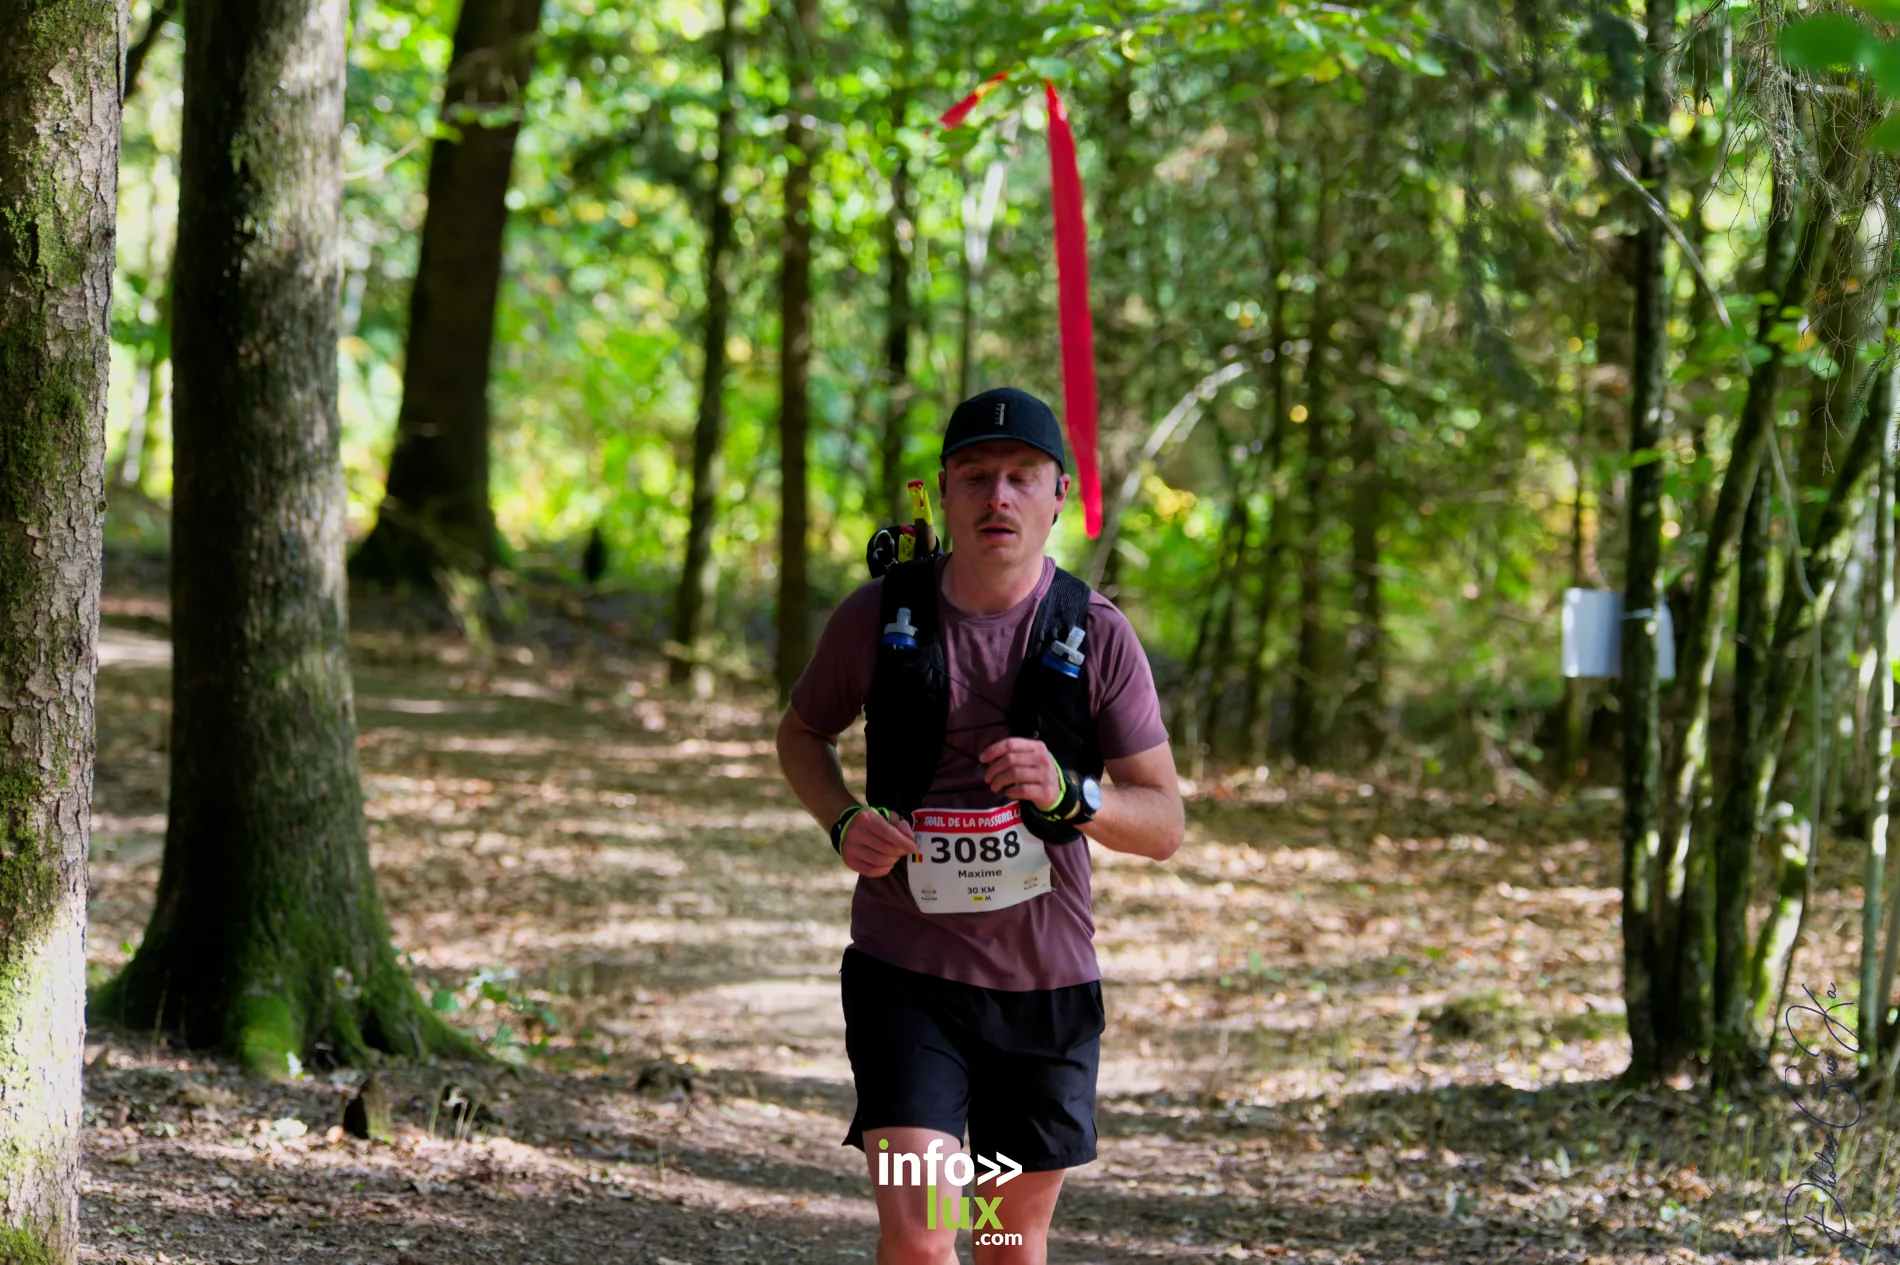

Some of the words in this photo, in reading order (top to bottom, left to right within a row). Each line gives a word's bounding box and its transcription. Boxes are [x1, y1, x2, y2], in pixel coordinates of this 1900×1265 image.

[948, 817, 961, 828] DE
[963, 817, 976, 828] LA
[978, 807, 1021, 828] PASSERELL
[930, 830, 1021, 864] 3088
[958, 868, 1003, 878] Maxime
[967, 886, 979, 895] 30
[981, 885, 996, 894] KM
